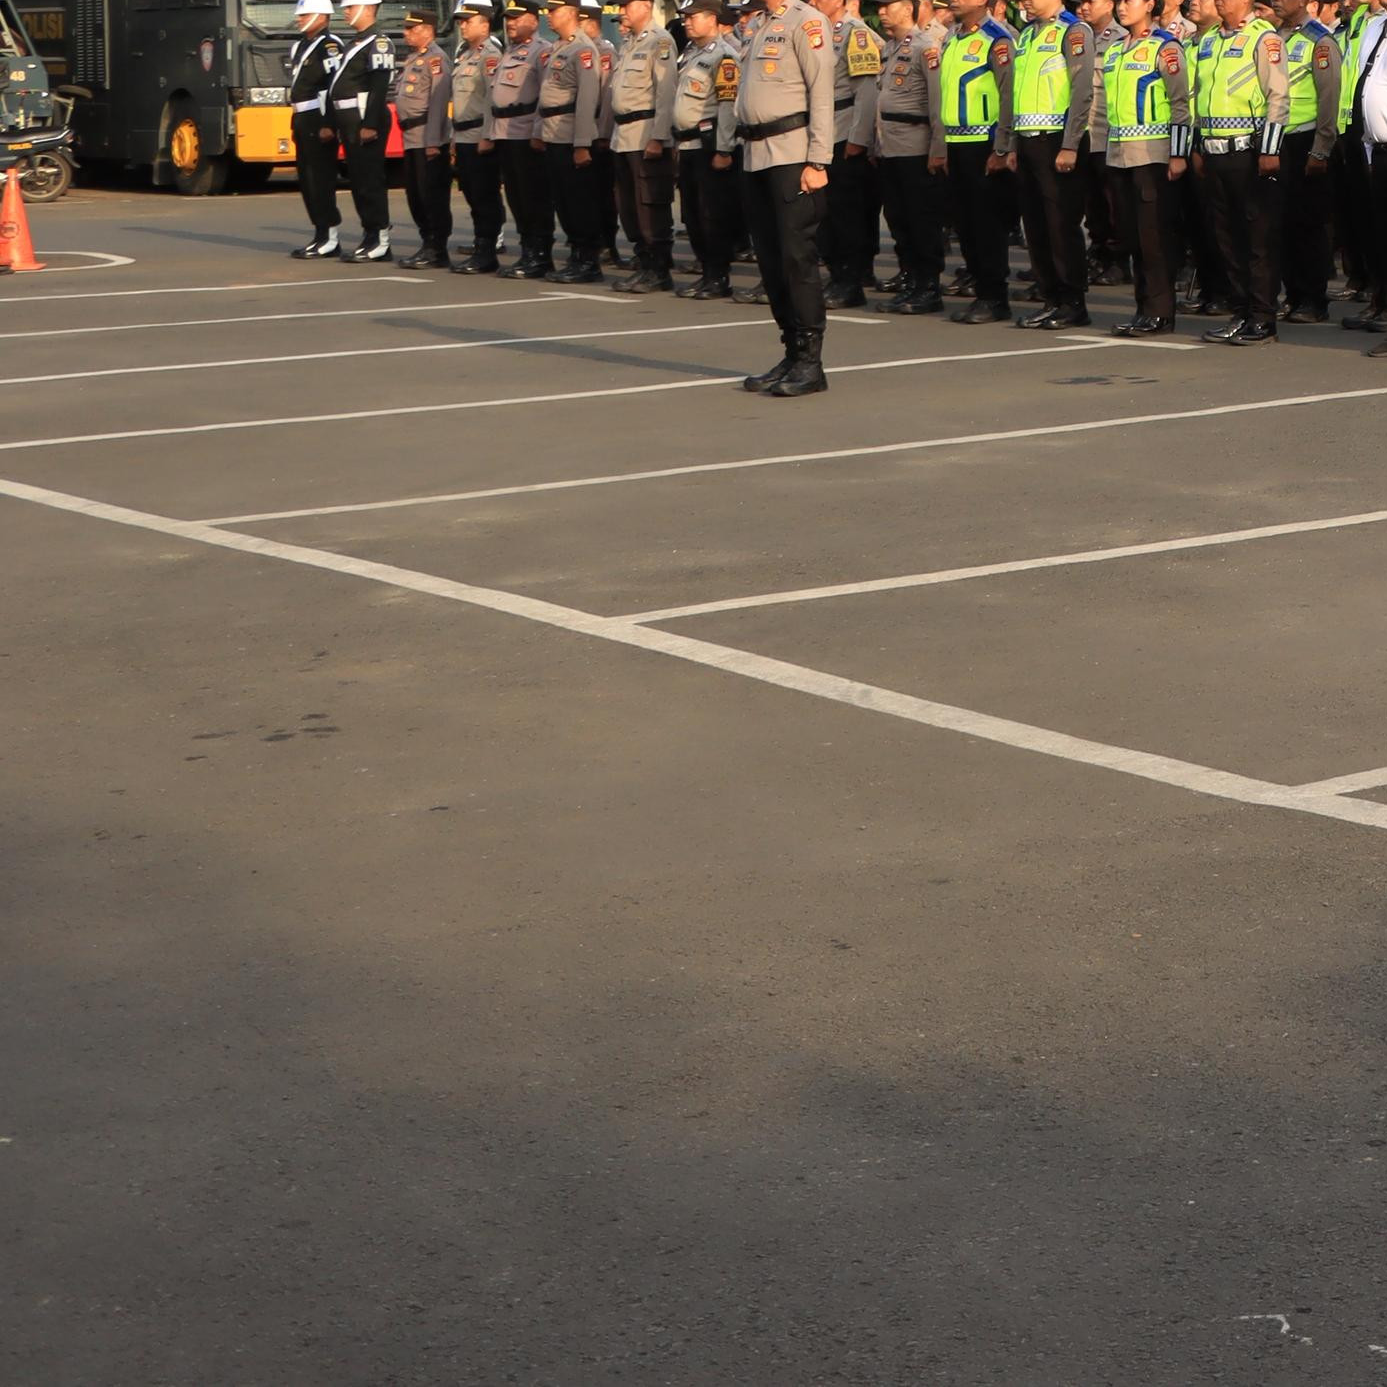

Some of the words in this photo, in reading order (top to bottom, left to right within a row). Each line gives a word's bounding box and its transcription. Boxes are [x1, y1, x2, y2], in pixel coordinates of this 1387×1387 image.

[22, 13, 63, 40] OLISI
[371, 53, 395, 70] PM
[9, 70, 26, 82] 48
